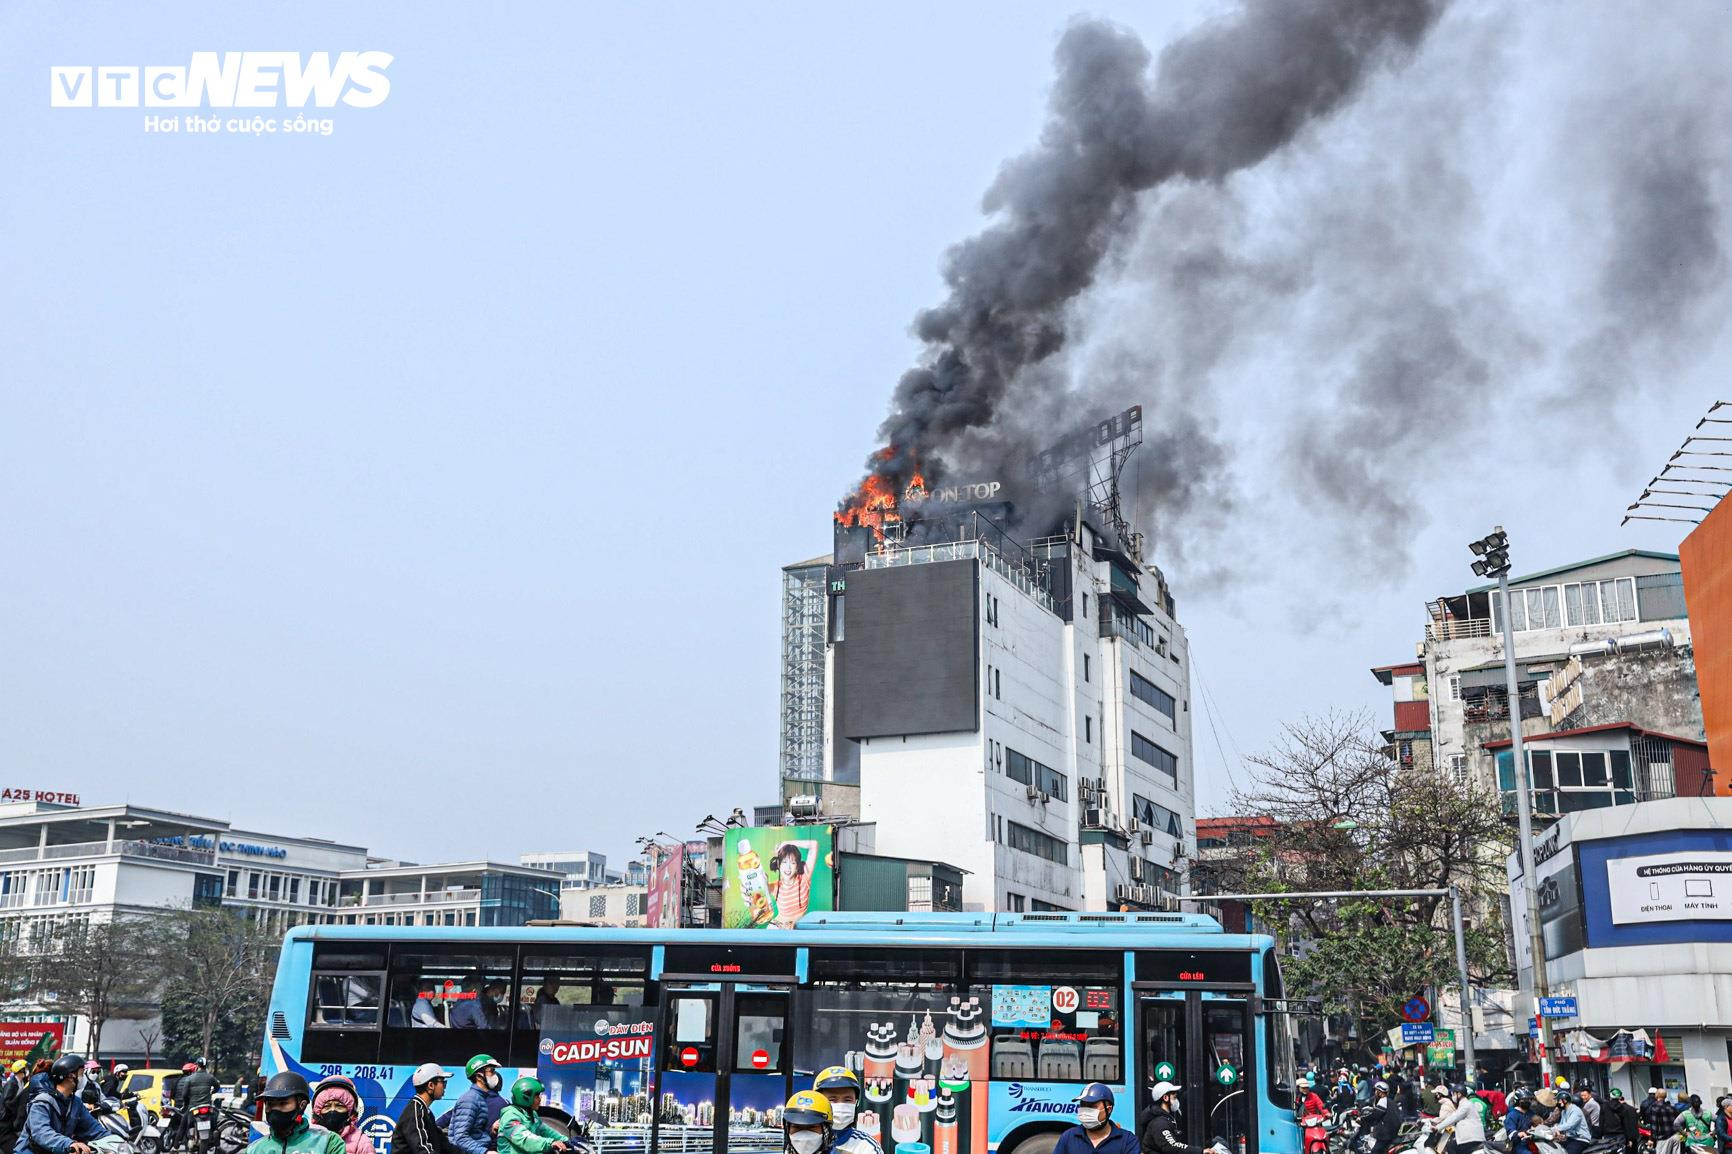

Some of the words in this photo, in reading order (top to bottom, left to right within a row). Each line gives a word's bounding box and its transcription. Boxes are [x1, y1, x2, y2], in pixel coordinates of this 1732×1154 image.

[2, 788, 31, 800] A25
[35, 791, 80, 805] HOTEL
[1684, 864, 1703, 872] HÀNG
[1684, 901, 1699, 909] MÁY
[1056, 991, 1075, 1008] 02
[553, 1039, 650, 1061] CADI-SUN
[355, 1066, 394, 1079] 208.41
